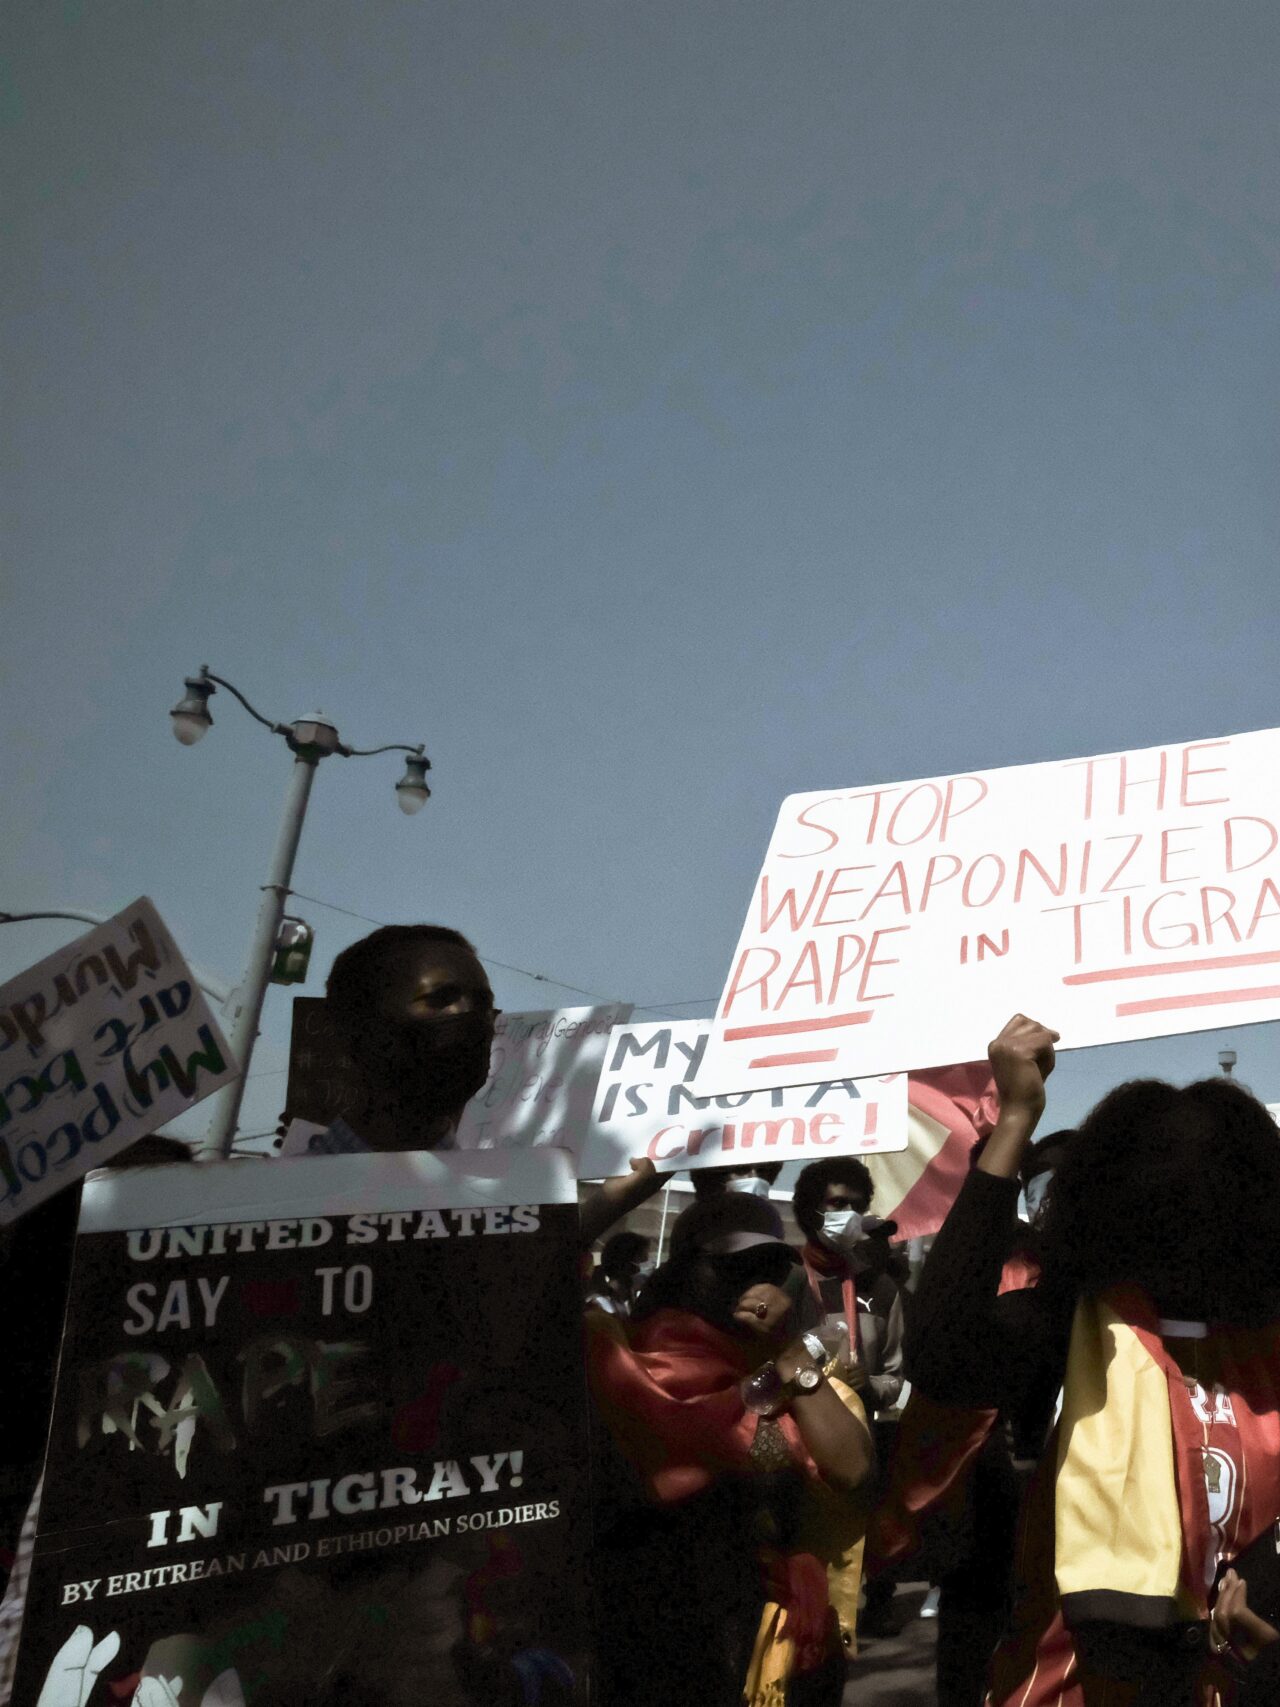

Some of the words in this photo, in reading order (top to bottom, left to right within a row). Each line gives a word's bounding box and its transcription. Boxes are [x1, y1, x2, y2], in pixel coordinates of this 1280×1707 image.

[777, 776, 989, 858] STOP
[1061, 740, 1232, 820] THE
[758, 815, 1279, 933] WEAPONIZED
[721, 925, 911, 1018] RAPE
[960, 928, 1012, 964] IN
[94, 981, 192, 1057] are
[609, 1029, 709, 1083] My
[123, 1023, 227, 1110] My
[598, 1082, 653, 1123] IS
[126, 1218, 334, 1262] UNITED
[346, 1205, 542, 1247] STATES
[123, 1275, 231, 1337] SAY
[313, 1264, 374, 1317] TO
[77, 1335, 384, 1454] RAPE
[146, 1501, 224, 1549] IN
[264, 1449, 525, 1526] TIGRAY!
[61, 1577, 102, 1606] BY
[105, 1551, 248, 1598] ERITREAN
[250, 1542, 312, 1570] AND
[316, 1516, 452, 1559] ETHIOPIAN
[455, 1499, 561, 1535] SOLDIERS
